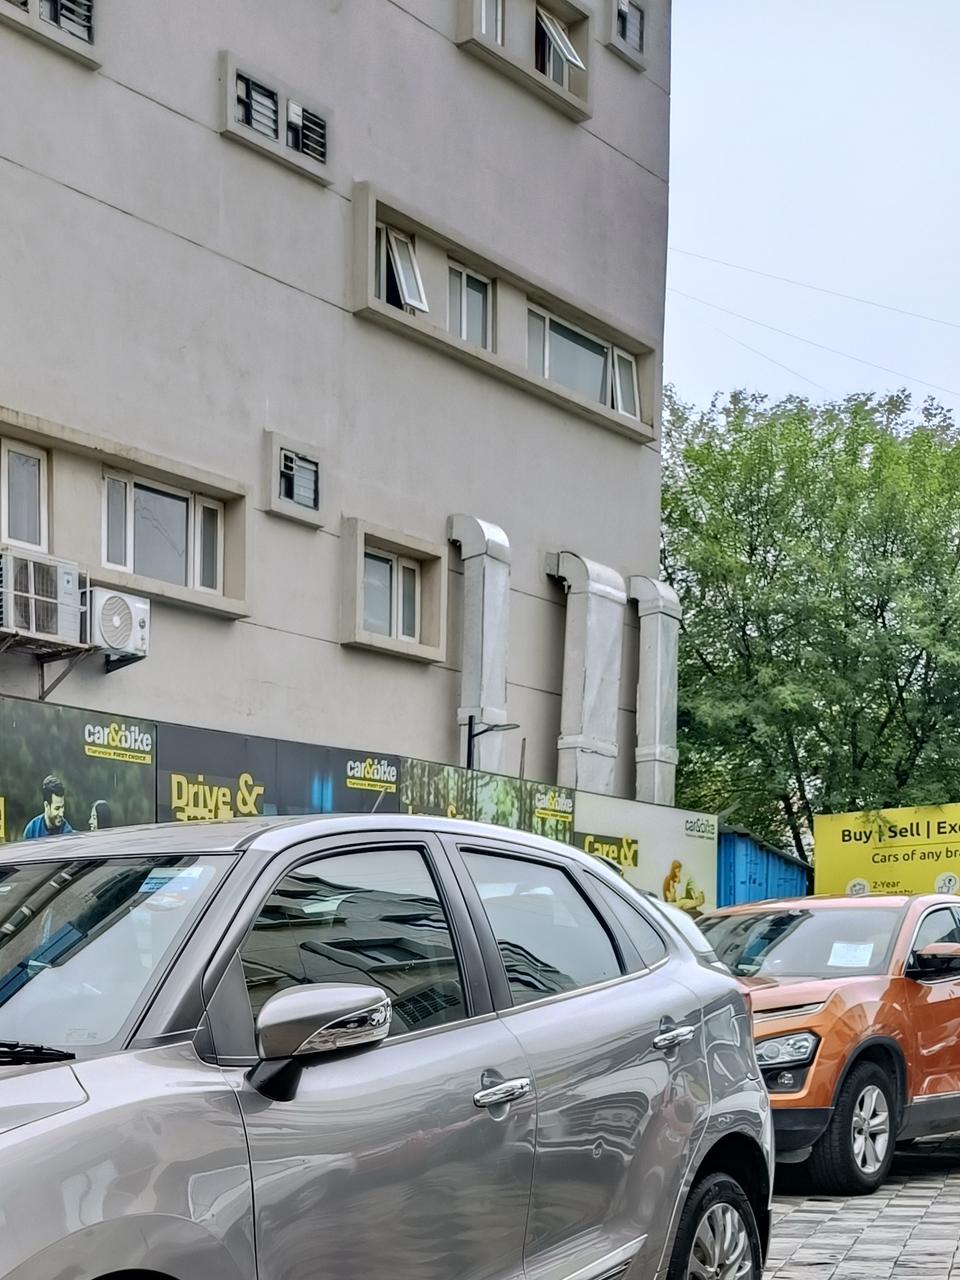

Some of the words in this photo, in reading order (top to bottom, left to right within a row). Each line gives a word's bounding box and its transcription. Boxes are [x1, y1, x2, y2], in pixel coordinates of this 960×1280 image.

[85, 723, 152, 752] car&bike
[346, 758, 397, 782] car&bike
[171, 774, 232, 811] Drive
[236, 773, 265, 815] &
[841, 829, 872, 844] Buy
[888, 822, 920, 839] Sell
[585, 835, 618, 862] Care
[872, 853, 899, 864] Cars
[902, 850, 916, 862] of
[919, 850, 942, 862] any
[872, 880, 901, 889] 2-Year
